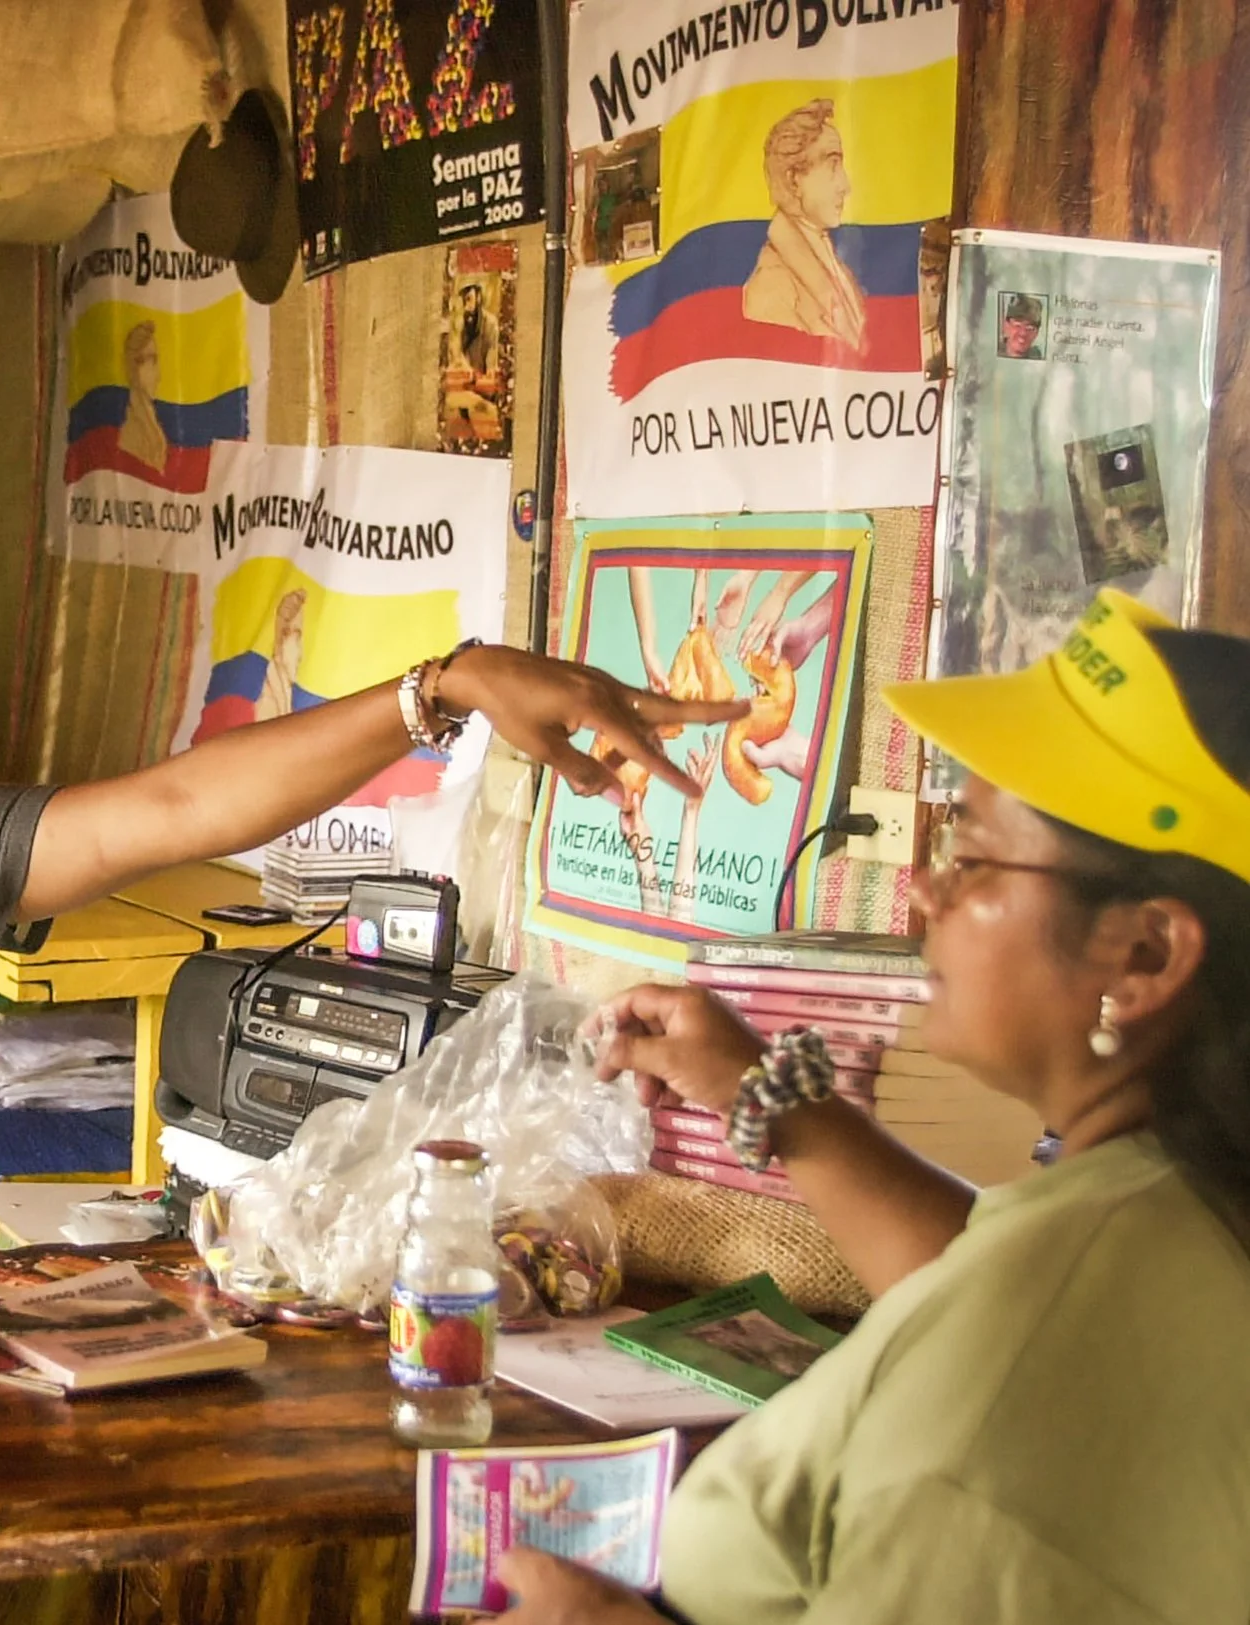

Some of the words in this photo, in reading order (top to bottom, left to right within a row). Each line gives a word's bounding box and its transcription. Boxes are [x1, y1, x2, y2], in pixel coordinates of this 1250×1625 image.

[589, 0, 790, 142] MOVIMIENTO
[432, 142, 520, 187] Semana
[436, 195, 460, 218] por
[462, 188, 476, 208] la
[481, 169, 523, 203] PAZ
[484, 201, 523, 225] 2000
[1052, 331, 1091, 344] Gabriel
[631, 411, 681, 456] POR
[688, 407, 725, 450] LA
[730, 397, 834, 448] NUEVA
[212, 493, 313, 560] MOVIMIENT
[304, 488, 455, 561] BOLIVARIANO
[556, 853, 599, 879] Participe
[601, 864, 616, 881] en
[618, 867, 634, 887] las
[699, 883, 759, 914] Públicas
